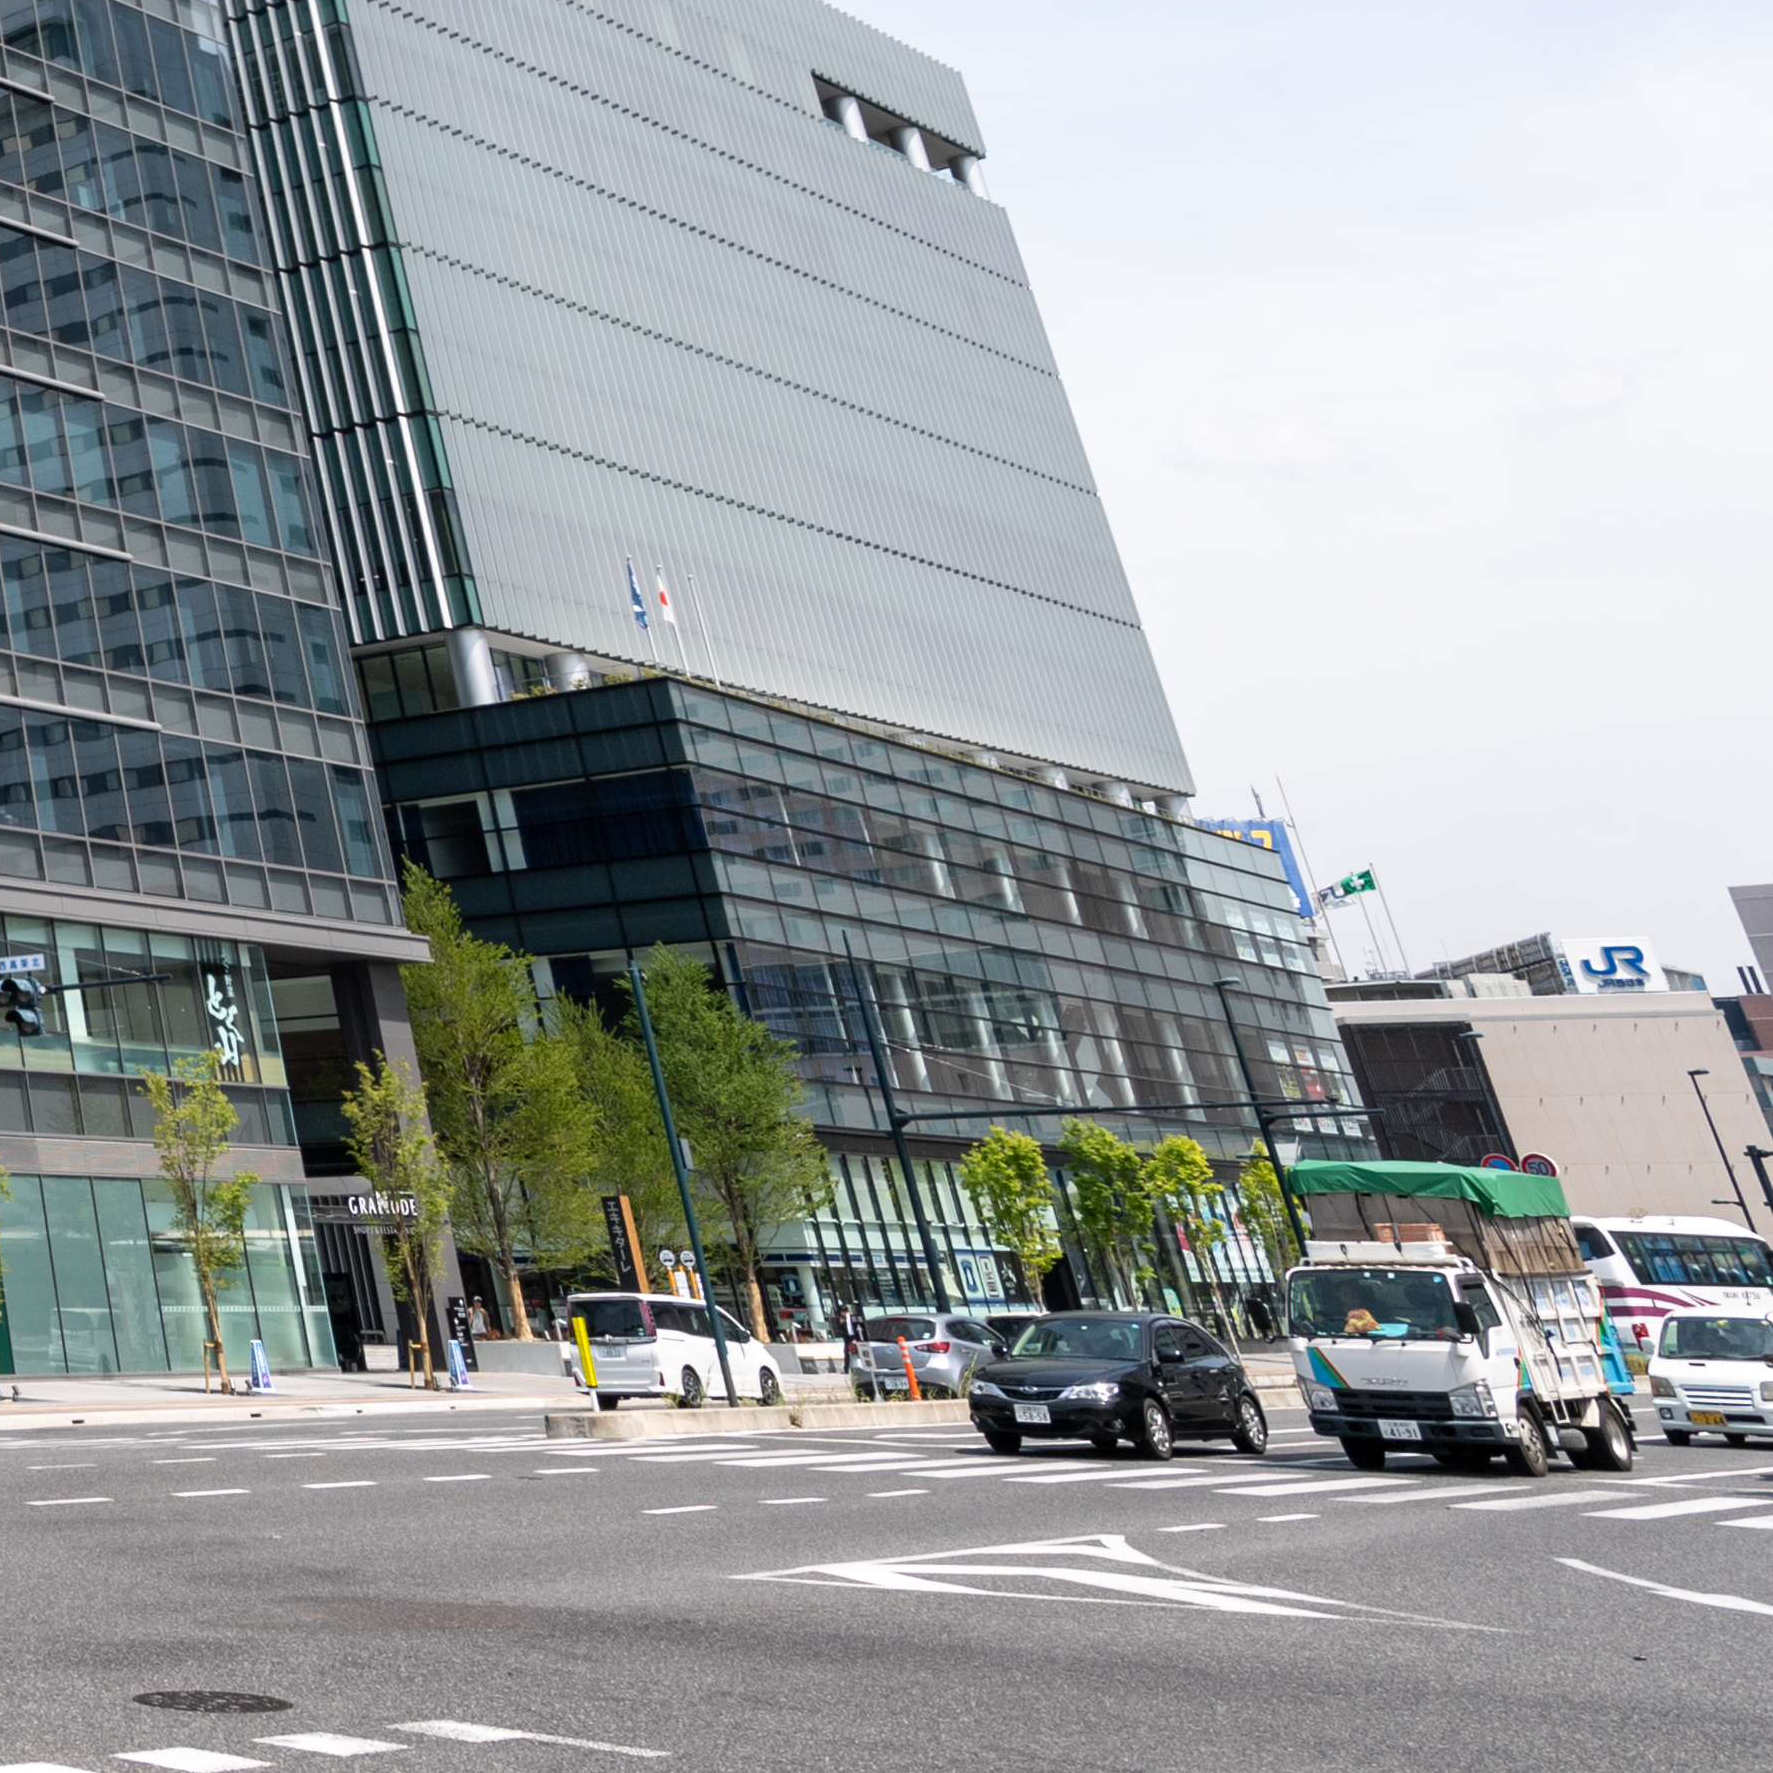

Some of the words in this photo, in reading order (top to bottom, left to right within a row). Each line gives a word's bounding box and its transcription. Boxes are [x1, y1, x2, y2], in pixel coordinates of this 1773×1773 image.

[1581, 945, 1649, 976] JR
[1527, 1160, 1550, 1175] 50
[607, 1201, 632, 1273] エキキターレ
[1023, 1410, 1048, 1422] 58-58
[1390, 1427, 1418, 1438] 41-91
